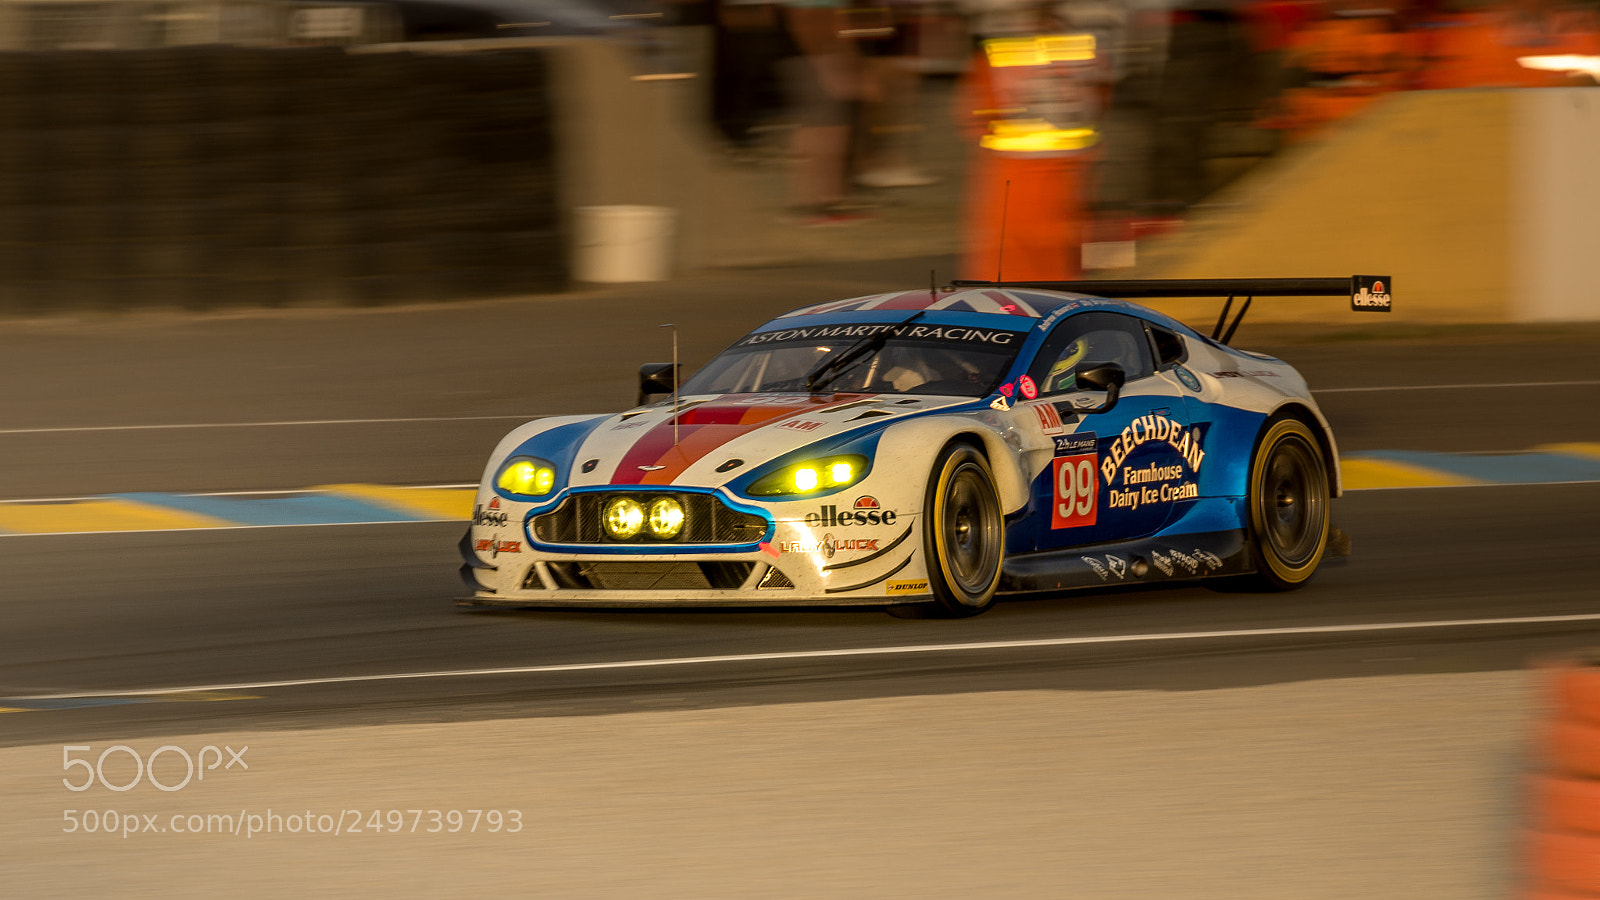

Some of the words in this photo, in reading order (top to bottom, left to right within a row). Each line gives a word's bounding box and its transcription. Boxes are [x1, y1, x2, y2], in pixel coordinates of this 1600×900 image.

[1353, 287, 1391, 307] ellesse
[740, 327, 816, 346] ASTON
[908, 326, 1014, 344] RACING
[781, 420, 821, 431] AM
[1033, 403, 1061, 430] AM
[1101, 415, 1205, 486] BEECHDEAN
[1123, 461, 1183, 485] Farmhouse
[1058, 460, 1094, 518] 99
[1109, 488, 1140, 510] Dairy
[1140, 487, 1159, 505] Ice
[1160, 483, 1198, 502] Cream
[804, 505, 897, 527] ellesse
[835, 539, 879, 551] LUCK
